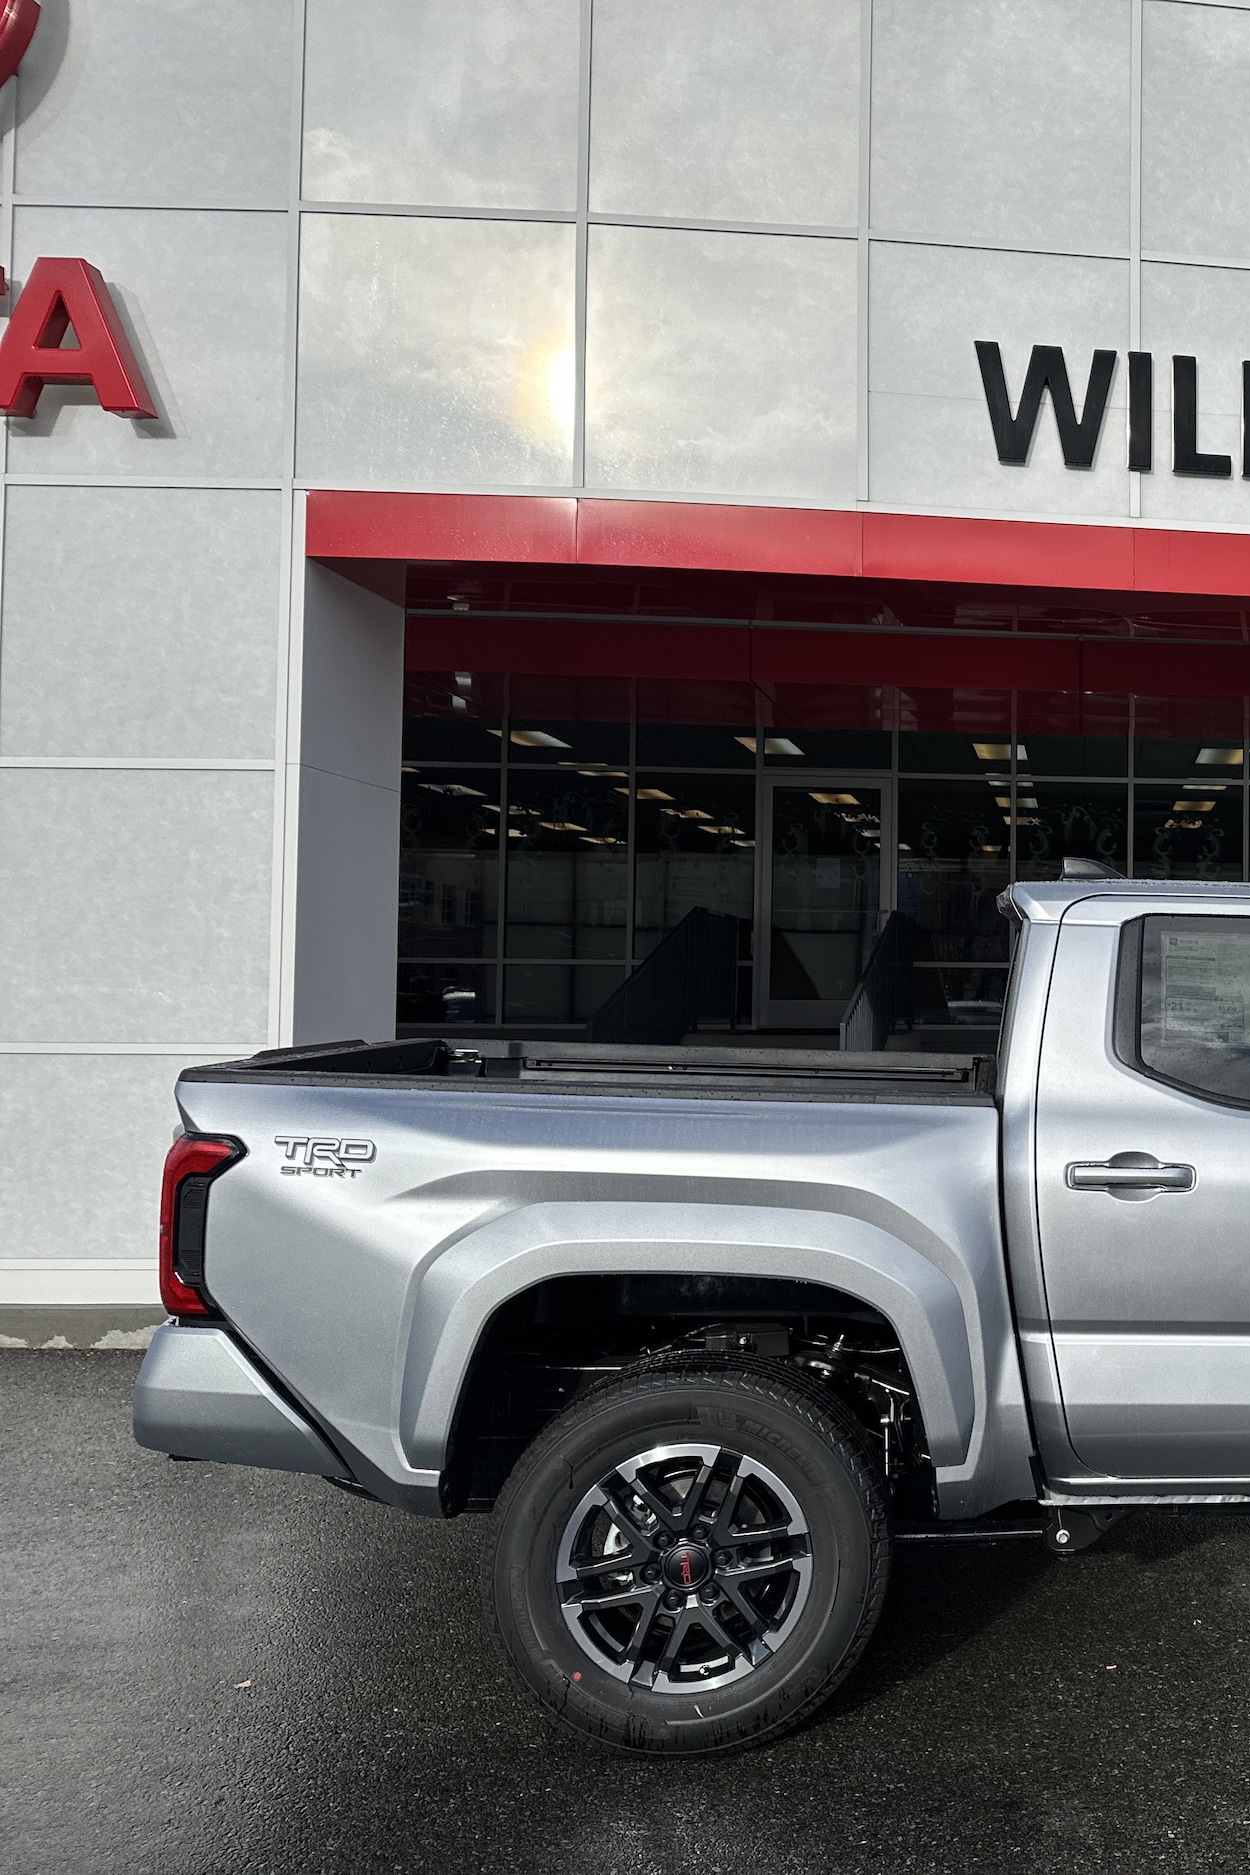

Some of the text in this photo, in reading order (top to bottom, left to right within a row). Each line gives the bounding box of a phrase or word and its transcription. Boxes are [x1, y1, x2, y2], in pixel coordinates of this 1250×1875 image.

[274, 1135, 377, 1165] TRD
[280, 1165, 363, 1179] SPORT
[743, 1418, 829, 1487] MICHELIN
[679, 1551, 691, 1585] TRD
